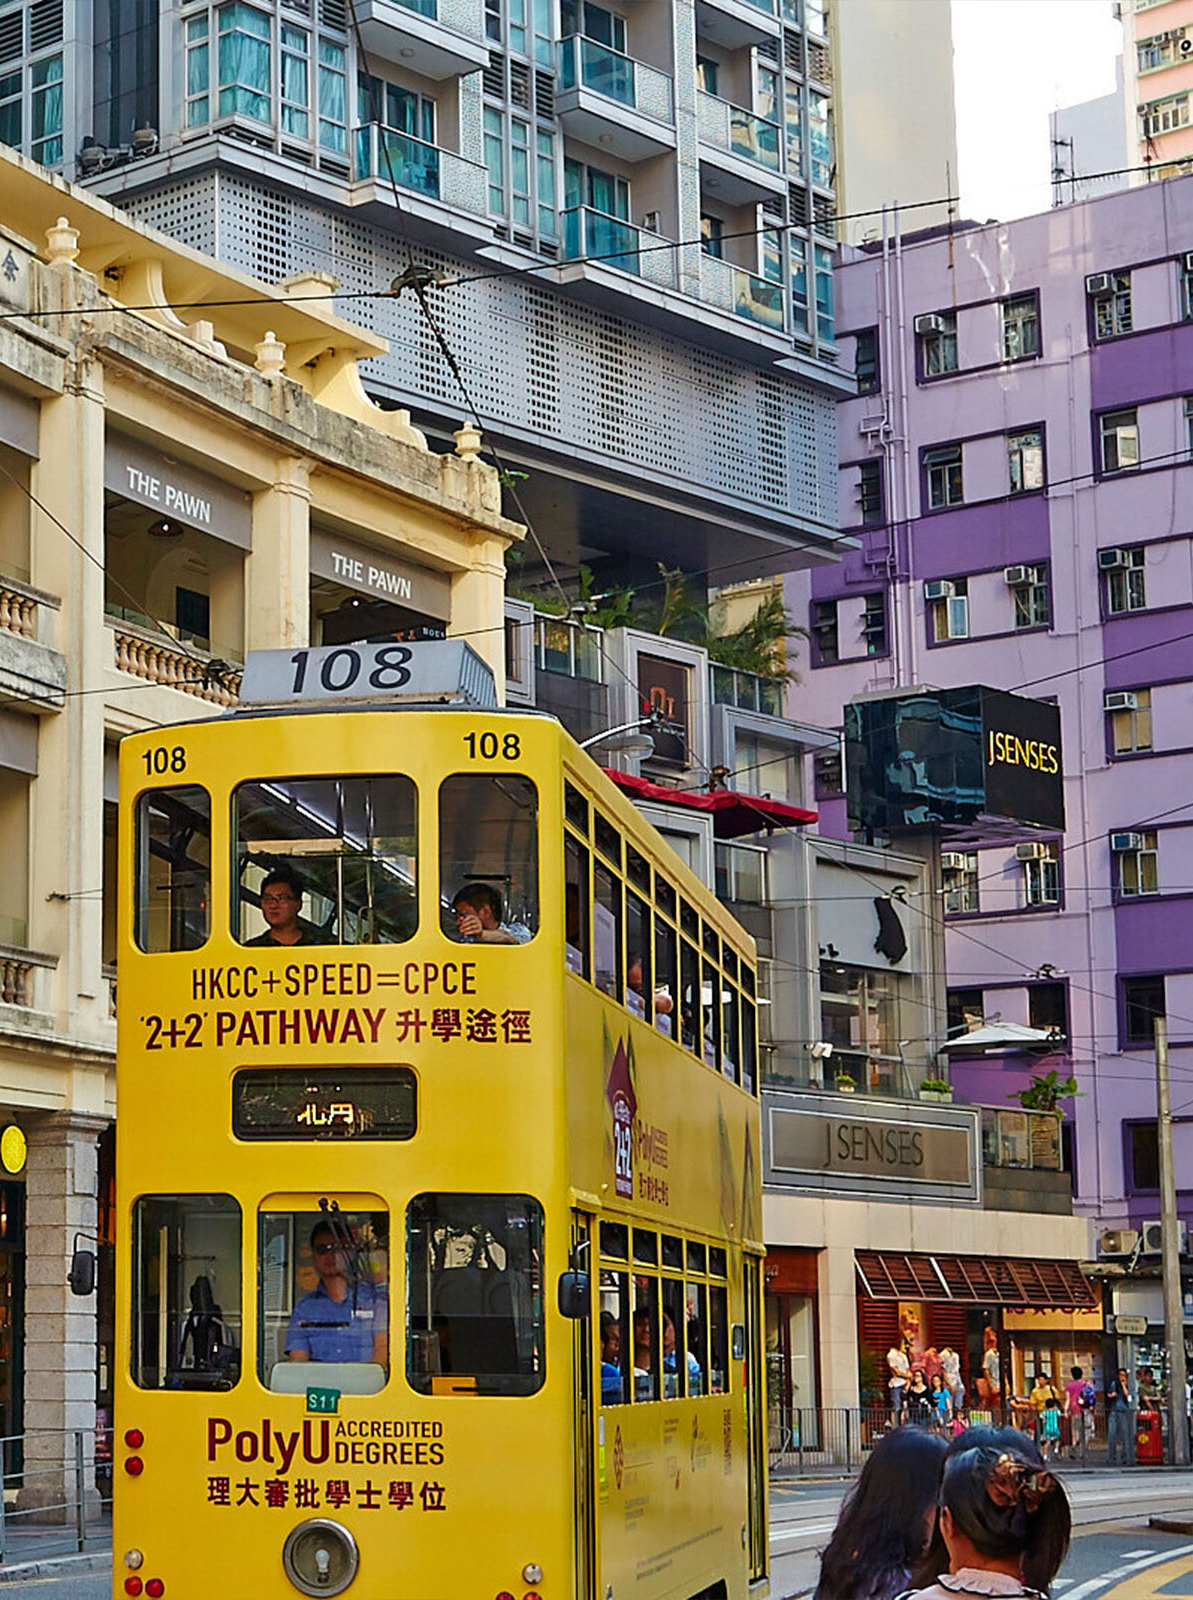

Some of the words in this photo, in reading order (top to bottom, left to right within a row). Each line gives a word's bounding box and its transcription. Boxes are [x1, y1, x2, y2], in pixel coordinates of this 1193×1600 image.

[126, 466, 159, 500] THE
[165, 485, 210, 523] PAWN
[331, 552, 363, 582] THE
[368, 566, 411, 599] PAWN
[291, 646, 413, 693] 108
[141, 746, 187, 776] 108
[463, 732, 521, 761] 108
[192, 962, 477, 1000] HKCC+SPEED=CPCE
[216, 1008, 387, 1046] PATHWAY
[396, 1008, 532, 1044] 升學途徑
[208, 1418, 330, 1475] PolyU
[335, 1421, 443, 1438] ACCREDITED
[335, 1442, 444, 1465] DEGREES
[207, 1477, 446, 1511] 理大審批學士學位
